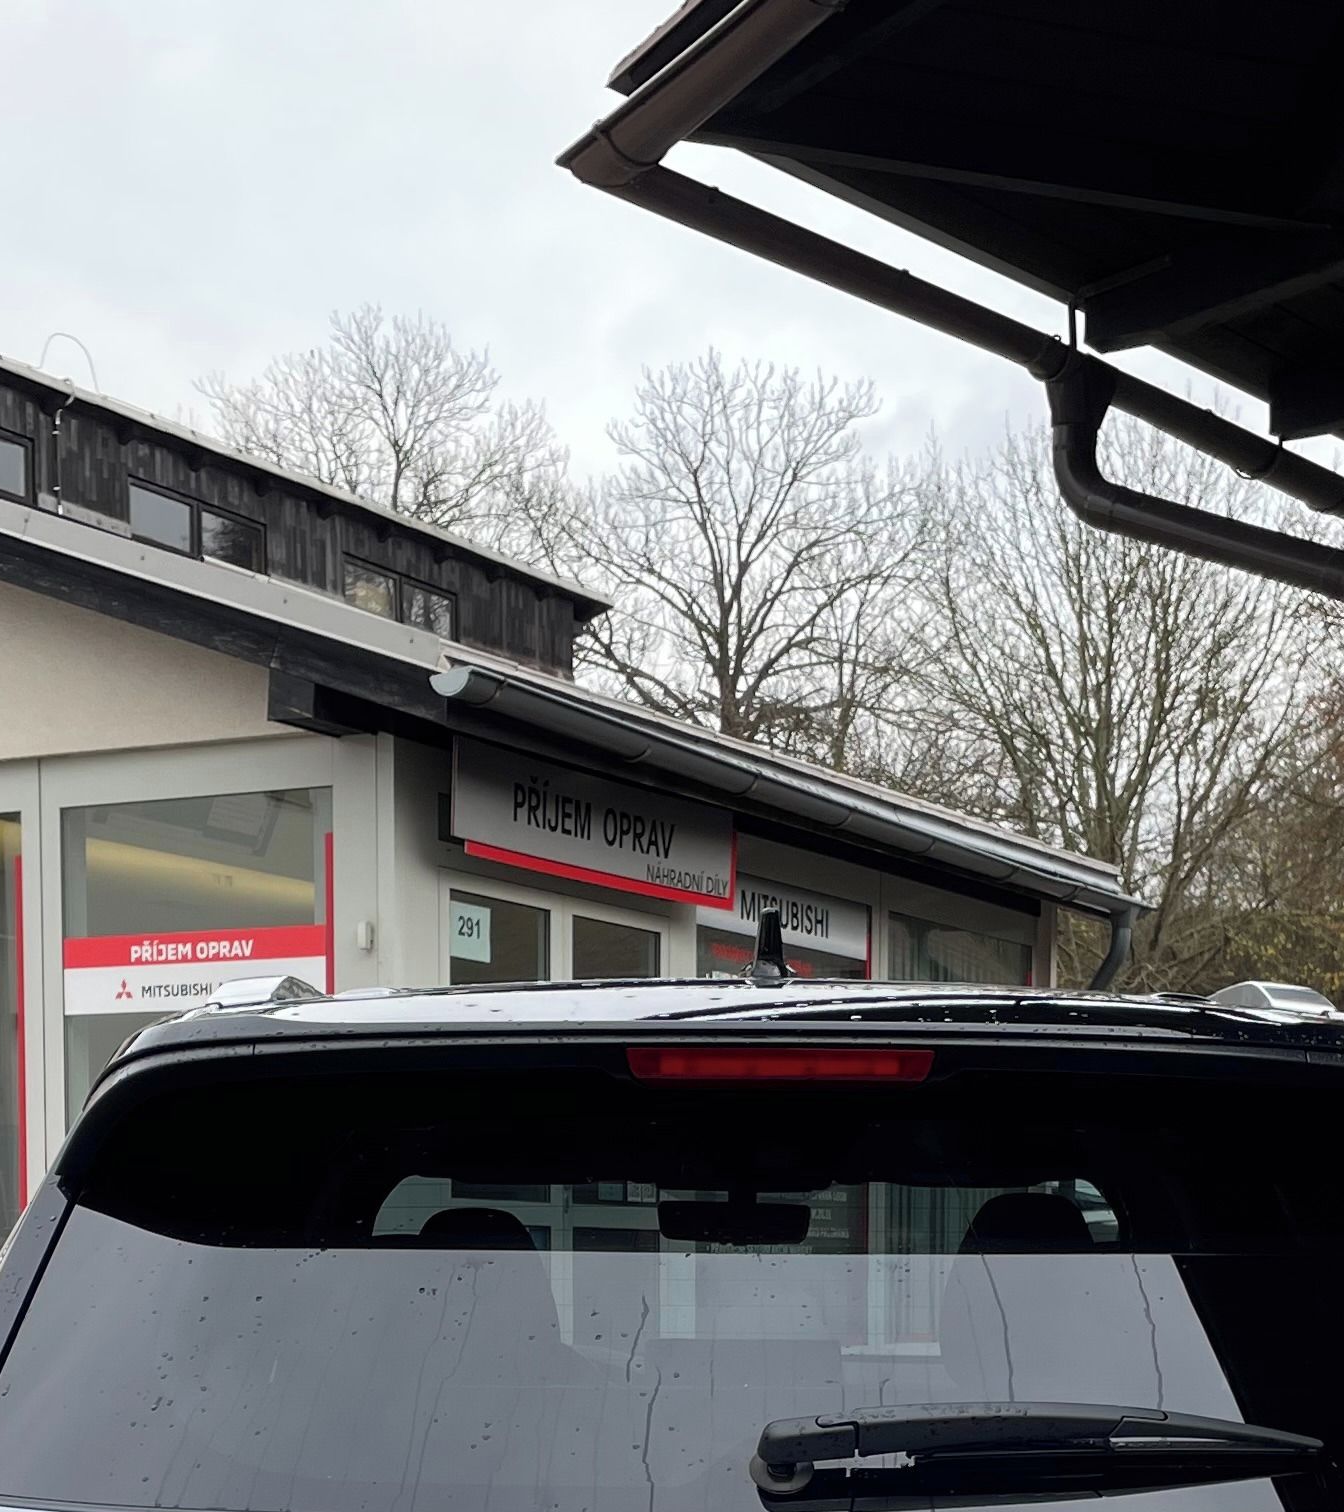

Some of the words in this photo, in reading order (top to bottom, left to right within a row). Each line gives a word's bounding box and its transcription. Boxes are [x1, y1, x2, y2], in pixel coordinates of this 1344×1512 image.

[513, 778, 592, 841] PŘÍJEM
[603, 807, 676, 859] OPRAV
[646, 862, 705, 891] NÁHRADNÍ
[706, 873, 729, 897] DÍLY
[458, 915, 481, 939] 291
[130, 940, 192, 963] PŘÍJEM
[196, 939, 254, 960] OPRAV
[141, 983, 213, 999] MITSUBISHI
